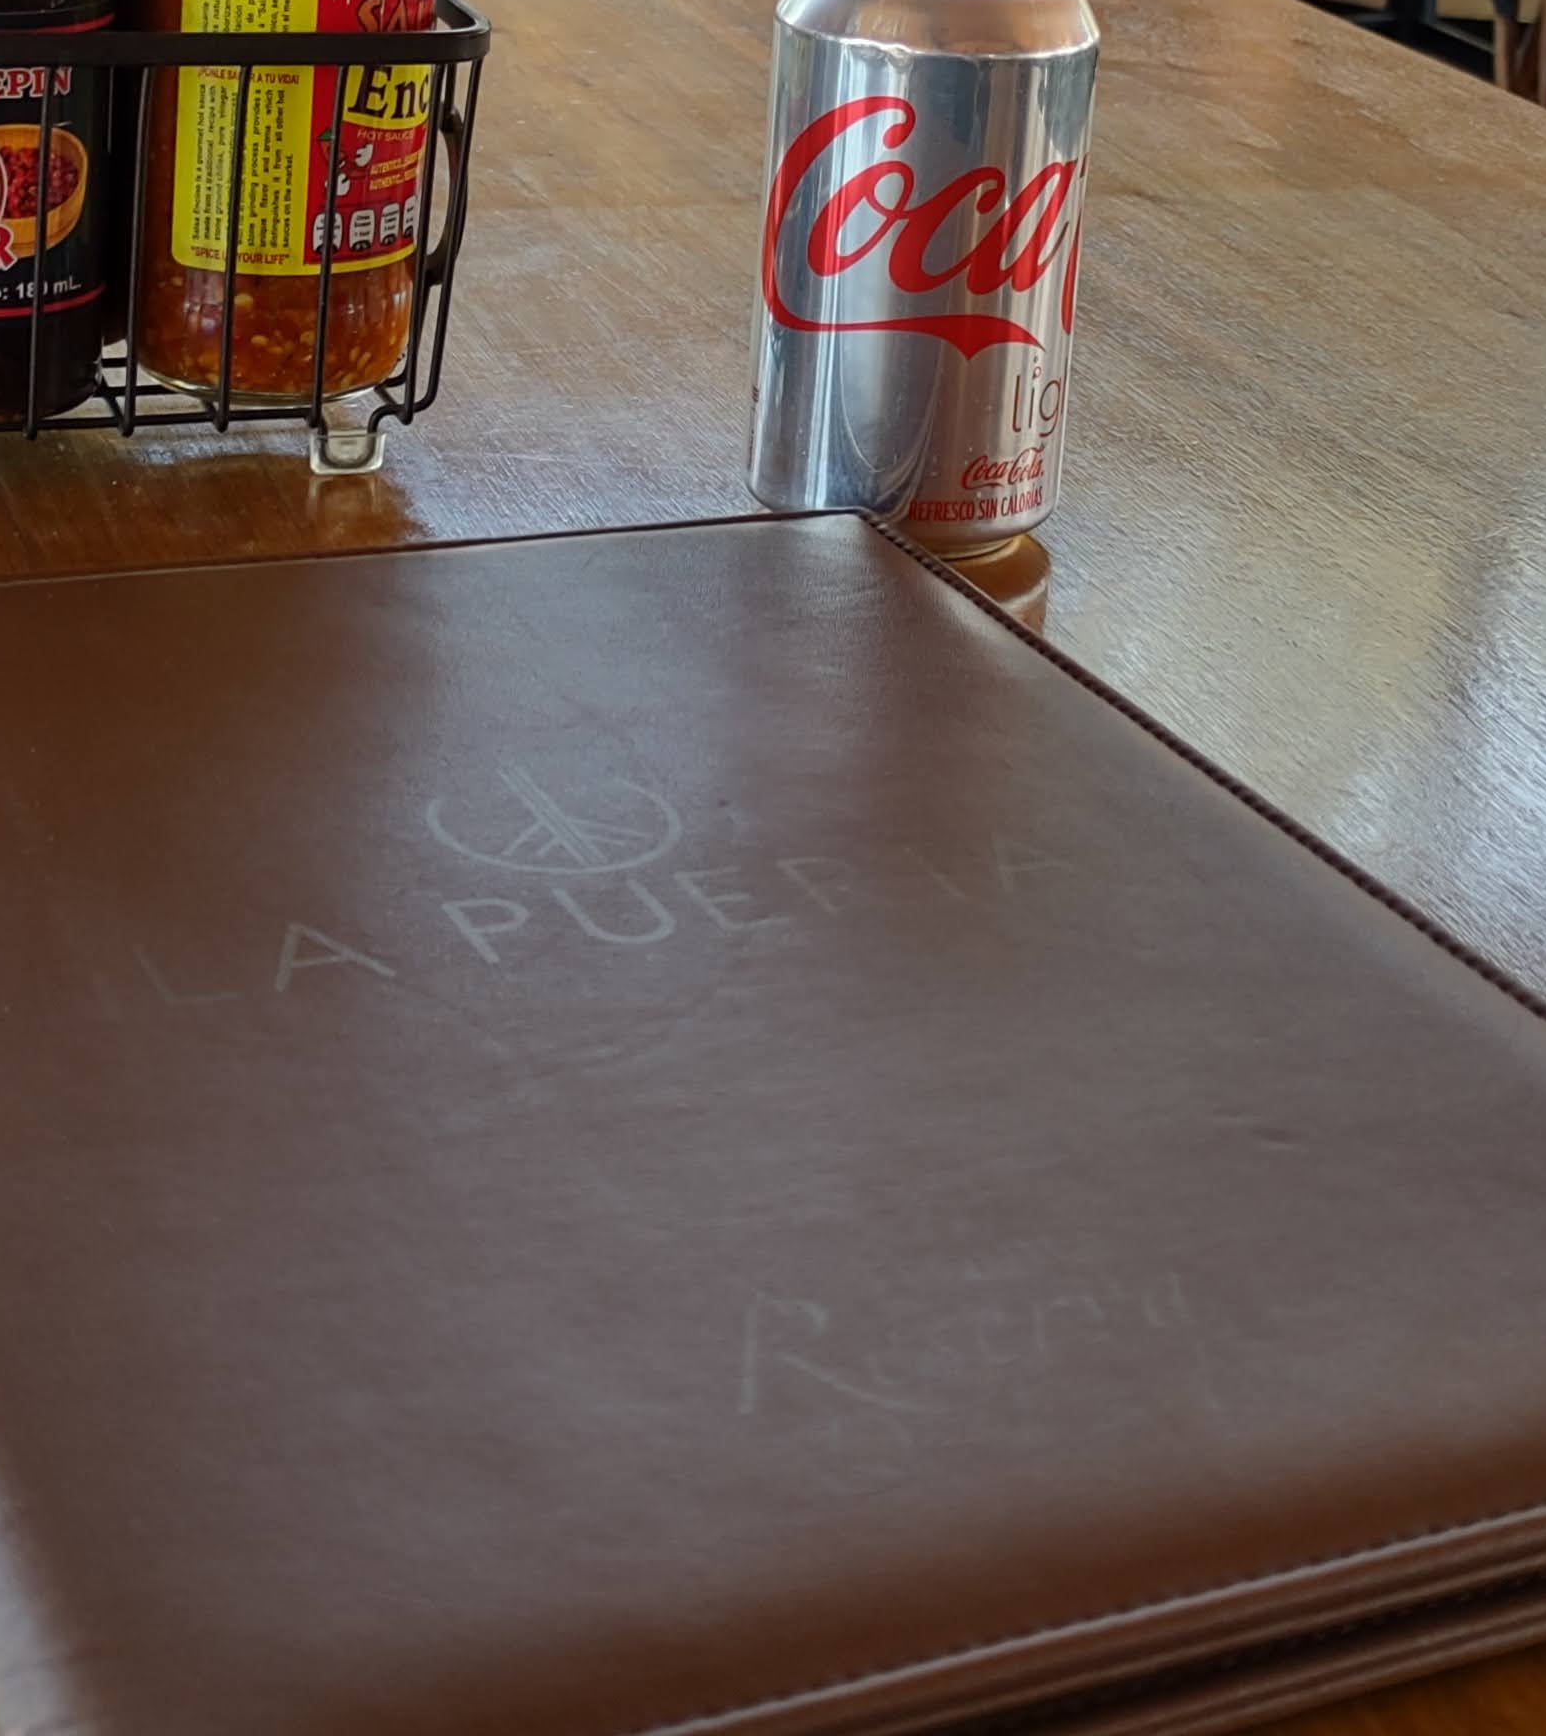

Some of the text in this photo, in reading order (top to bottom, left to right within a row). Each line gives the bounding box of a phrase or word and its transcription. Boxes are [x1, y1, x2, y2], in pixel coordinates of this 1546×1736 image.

[347, 64, 429, 119] Enc
[357, 129, 382, 141] HOT
[1012, 350, 1066, 438] lig
[908, 485, 1043, 522] REFRESCO SIN CALORÍAS
